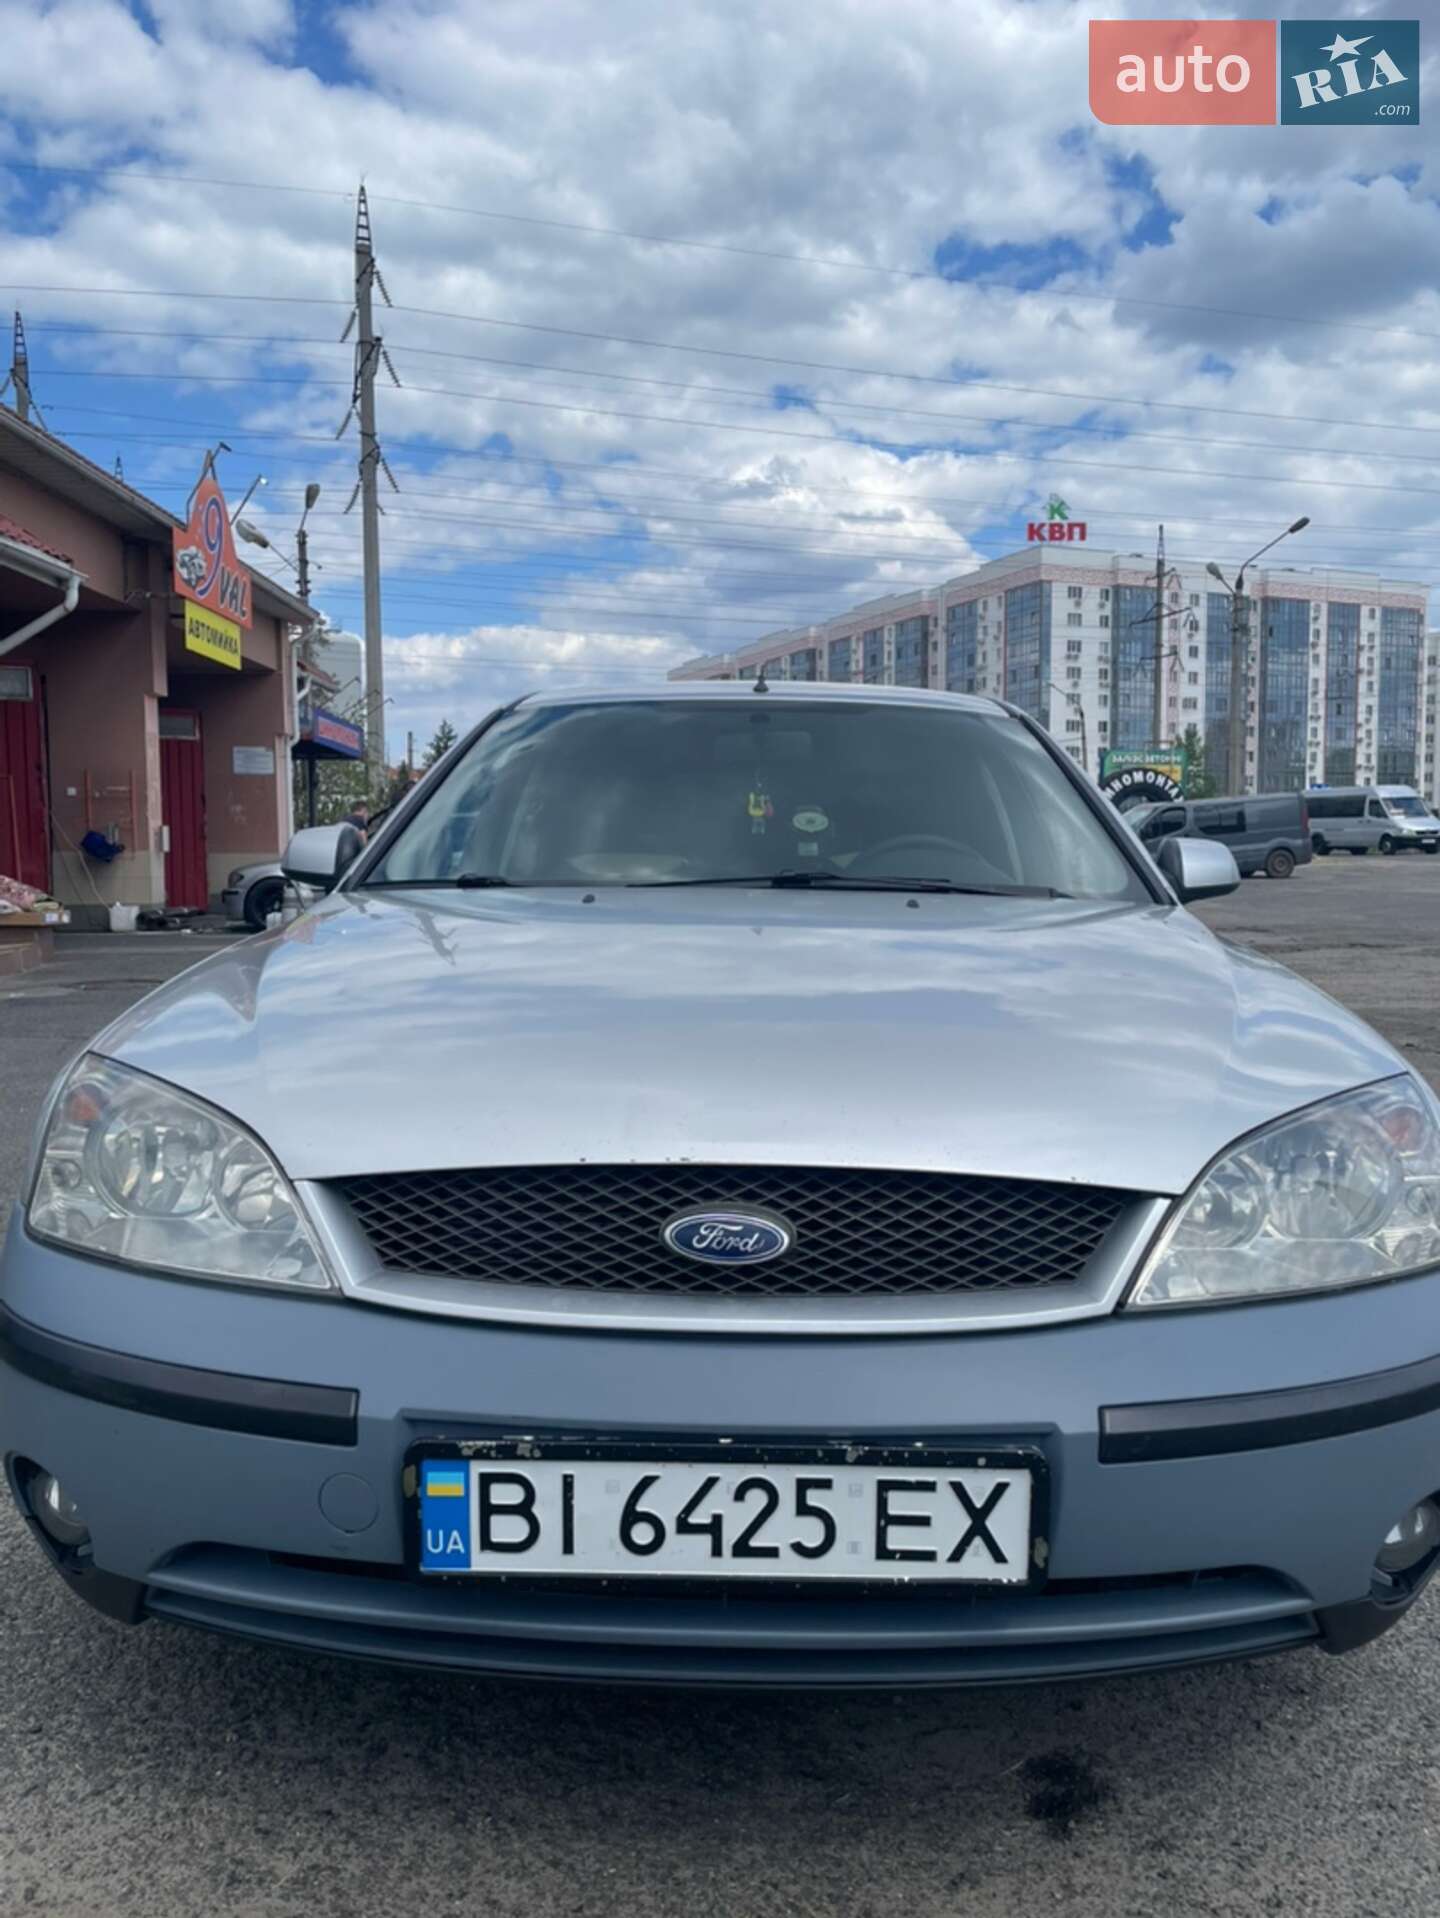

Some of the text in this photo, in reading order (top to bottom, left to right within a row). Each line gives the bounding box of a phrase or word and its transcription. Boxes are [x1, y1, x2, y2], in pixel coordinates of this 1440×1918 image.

[1027, 522, 1087, 542] КВП
[219, 564, 248, 620] VAL
[188, 616, 239, 655] АВТОМИЙКА
[692, 1222, 765, 1252] Ford
[478, 1471, 1011, 1563] BI 6425 EX
[426, 1530, 465, 1554] UA
